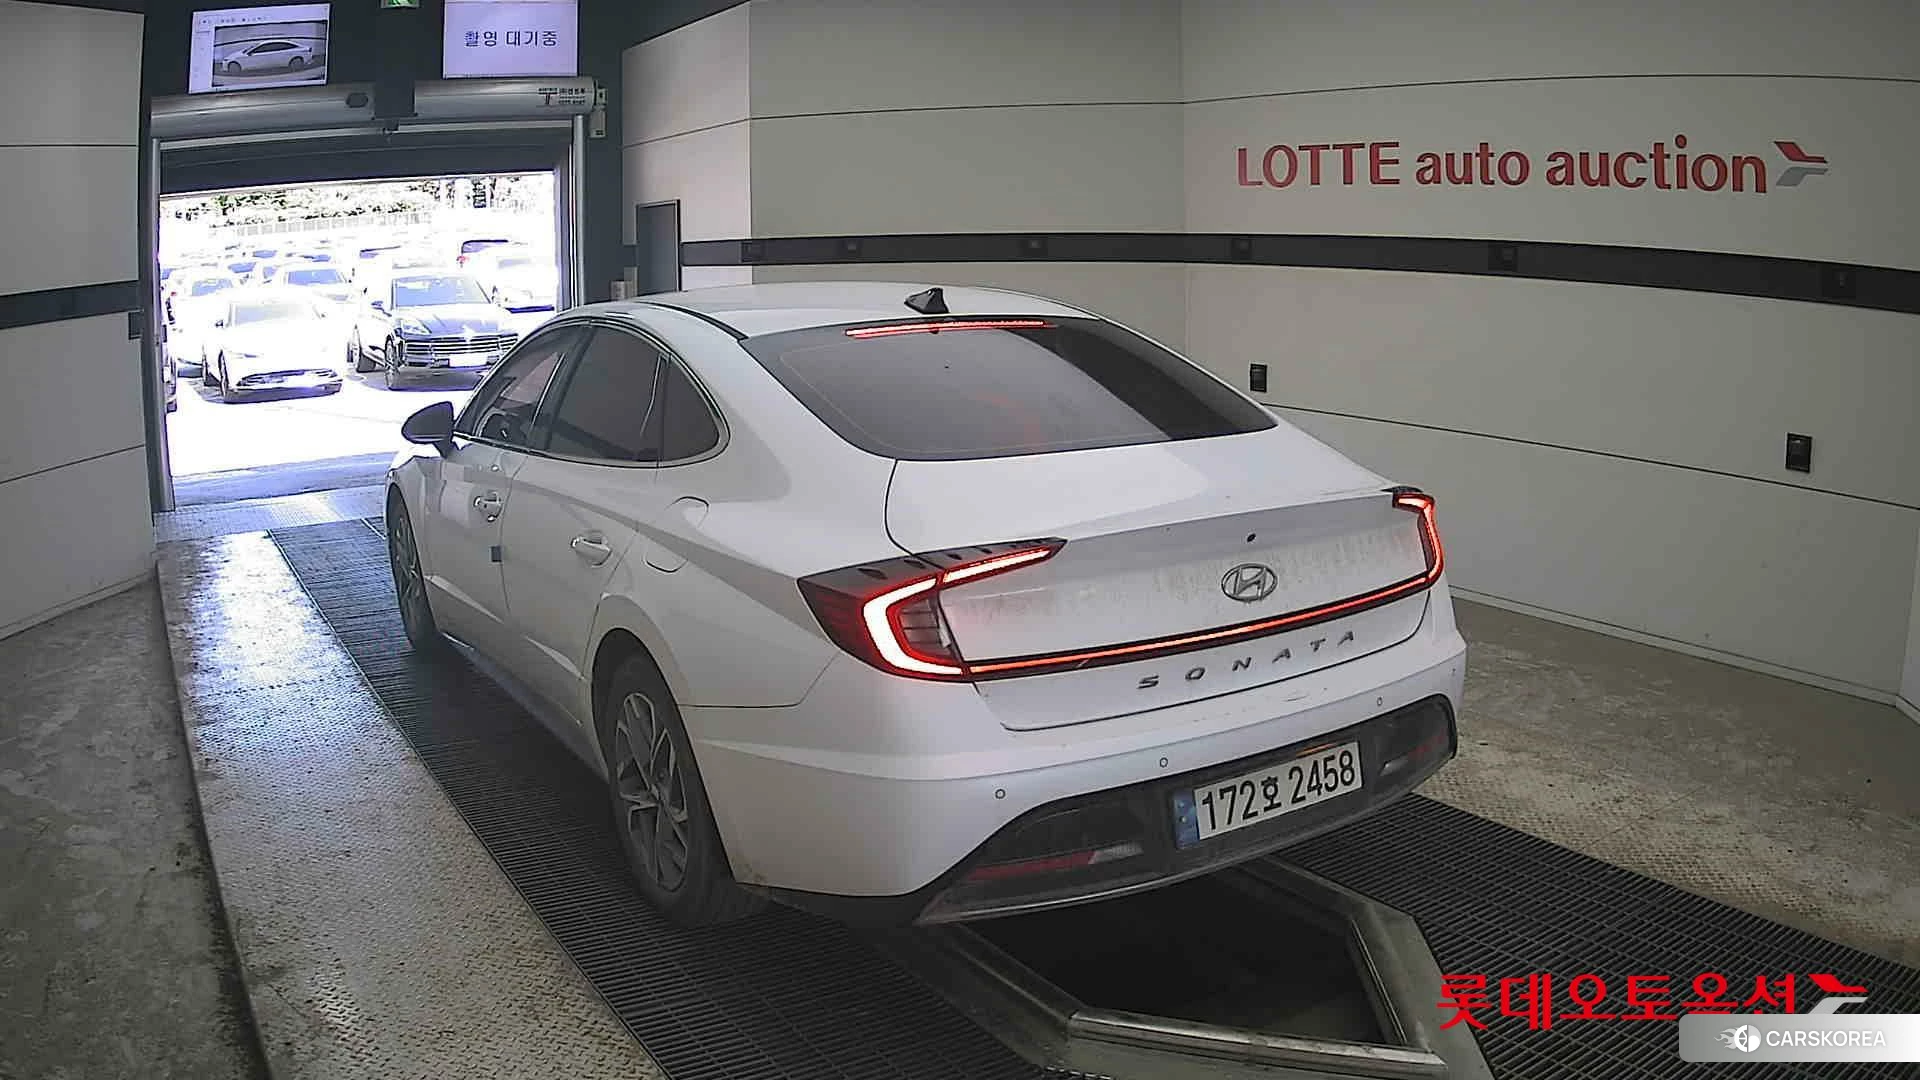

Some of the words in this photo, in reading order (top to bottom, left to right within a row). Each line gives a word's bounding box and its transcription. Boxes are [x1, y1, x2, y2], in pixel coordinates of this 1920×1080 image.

[464, 31, 497, 47] 촬영
[505, 30, 558, 47] 대기중
[1237, 141, 1400, 188] LOTTE
[1415, 142, 1530, 187] auto
[1545, 134, 1767, 193] auction
[1135, 630, 1356, 690] SONATA
[1201, 775, 1282, 830] 172호
[1287, 749, 1356, 805] 2458
